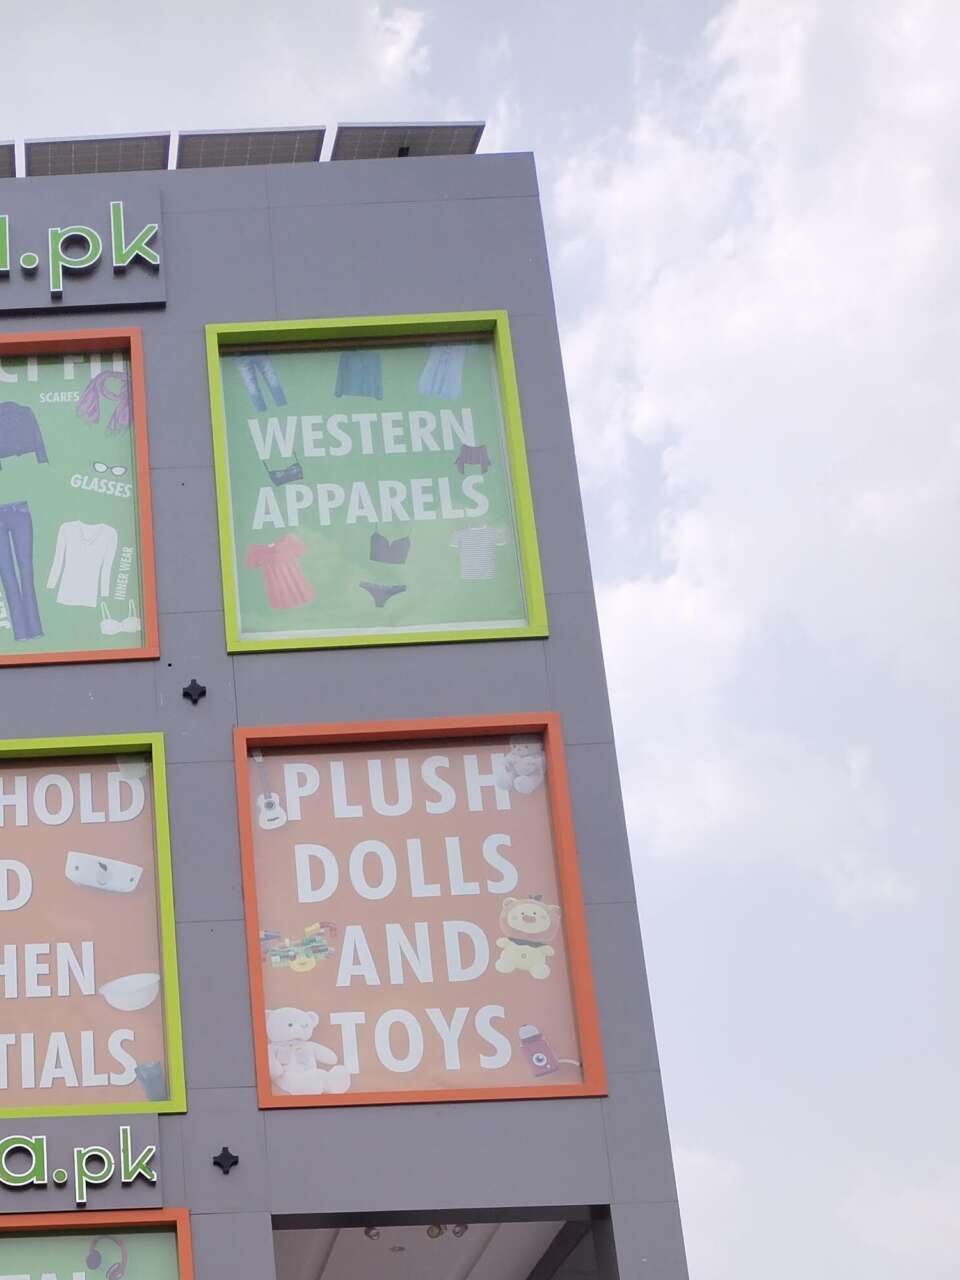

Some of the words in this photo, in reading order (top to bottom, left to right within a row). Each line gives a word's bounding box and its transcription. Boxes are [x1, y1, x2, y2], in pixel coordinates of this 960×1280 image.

[247, 408, 477, 460] WESTERN
[70, 473, 133, 499] GLASSES
[251, 474, 490, 530] APPARELS
[119, 545, 136, 571] WEAR
[113, 573, 130, 601] INNER
[282, 752, 512, 821] PLUSH
[293, 833, 519, 903] DOLLS
[335, 920, 490, 987] AND
[329, 1004, 513, 1075] TOYS
